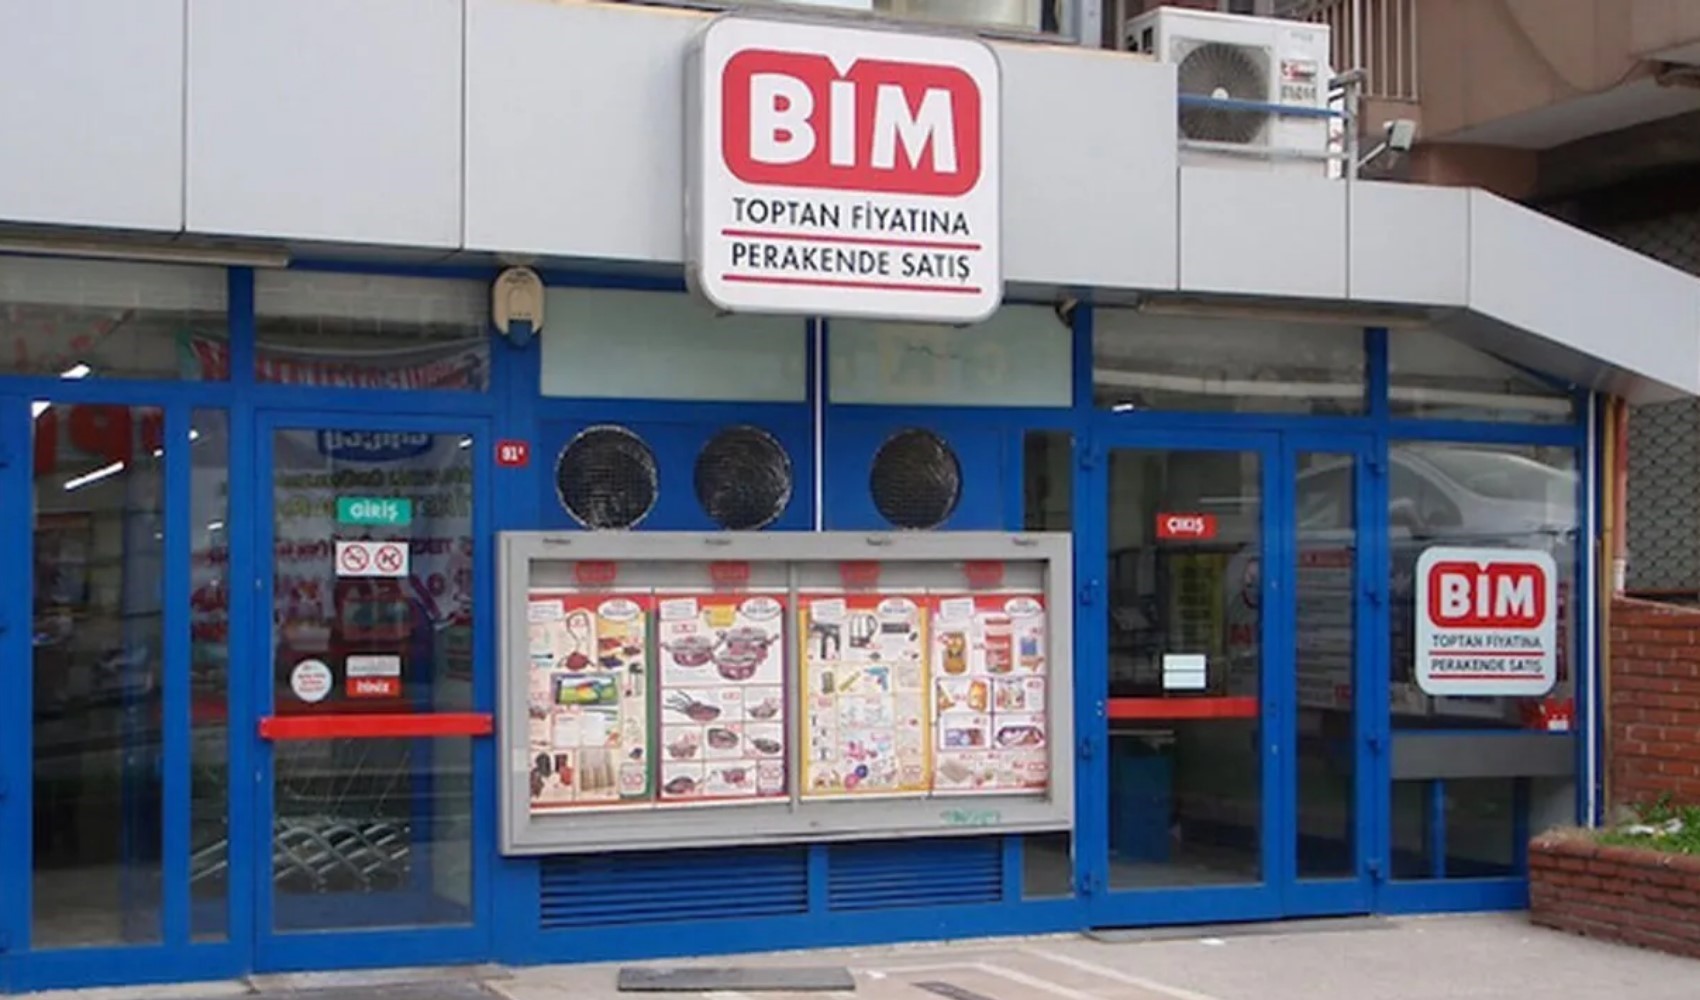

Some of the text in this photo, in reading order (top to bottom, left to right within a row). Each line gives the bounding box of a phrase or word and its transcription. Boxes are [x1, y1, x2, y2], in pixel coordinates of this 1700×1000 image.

[732, 196, 970, 236] TOPTAN FİYATINA
[731, 242, 970, 283] PERAKENDE SATIŞ
[1432, 634, 1542, 649] TOPTAN FİYATINA
[1431, 658, 1505, 671] PERAKENDE
